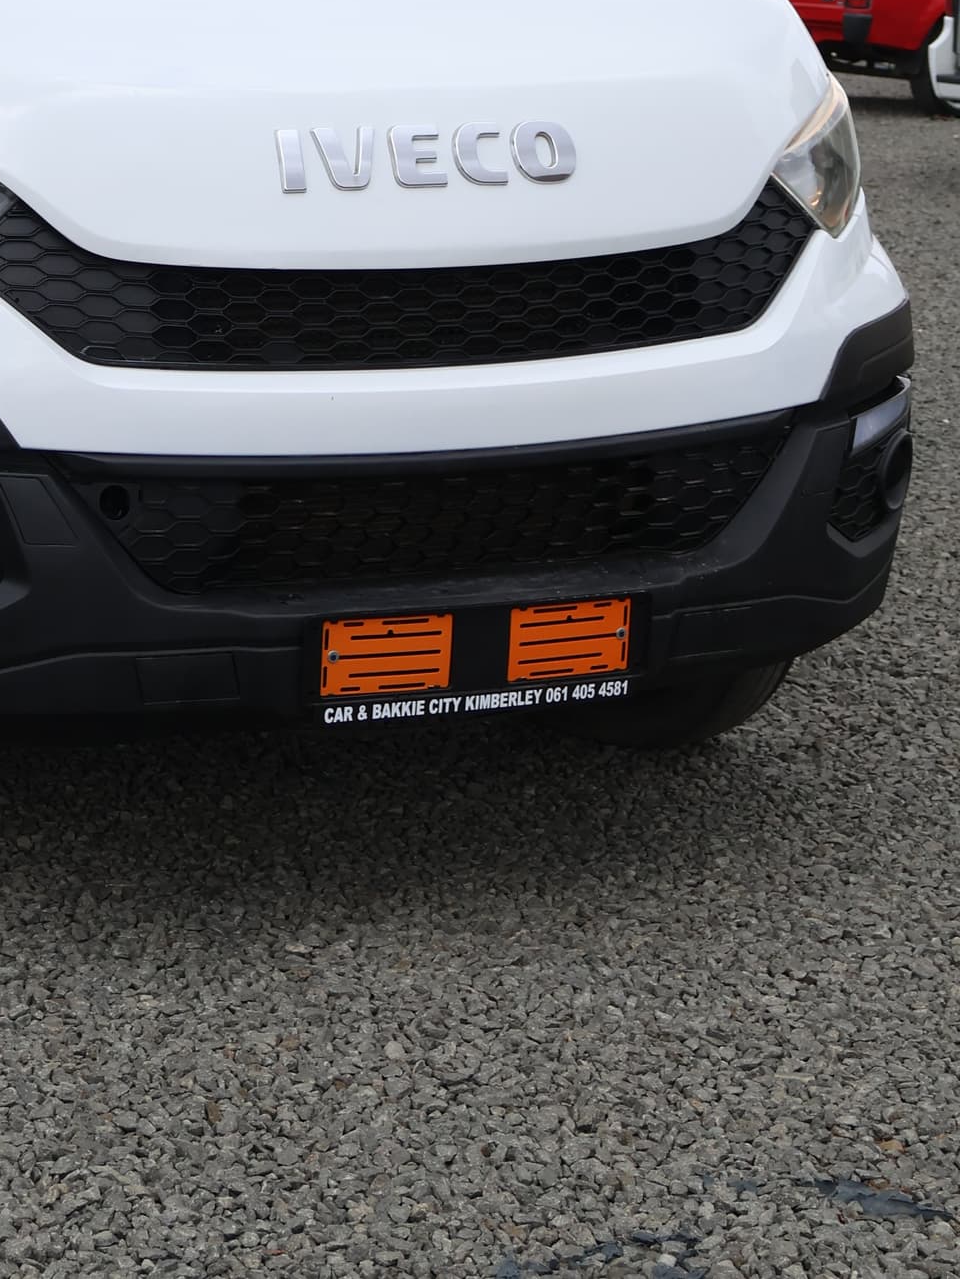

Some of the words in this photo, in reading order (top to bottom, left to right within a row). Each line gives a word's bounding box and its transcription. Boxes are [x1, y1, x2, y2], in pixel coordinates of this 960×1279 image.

[275, 121, 577, 194] IVECO
[324, 704, 353, 723] CAR
[357, 705, 368, 720] &
[372, 700, 425, 719] BAKKIE
[429, 696, 462, 714] CITY
[465, 688, 543, 711] KIMBERLEY
[545, 685, 568, 703] 061
[572, 683, 595, 701] 405
[598, 680, 628, 698] 4581
